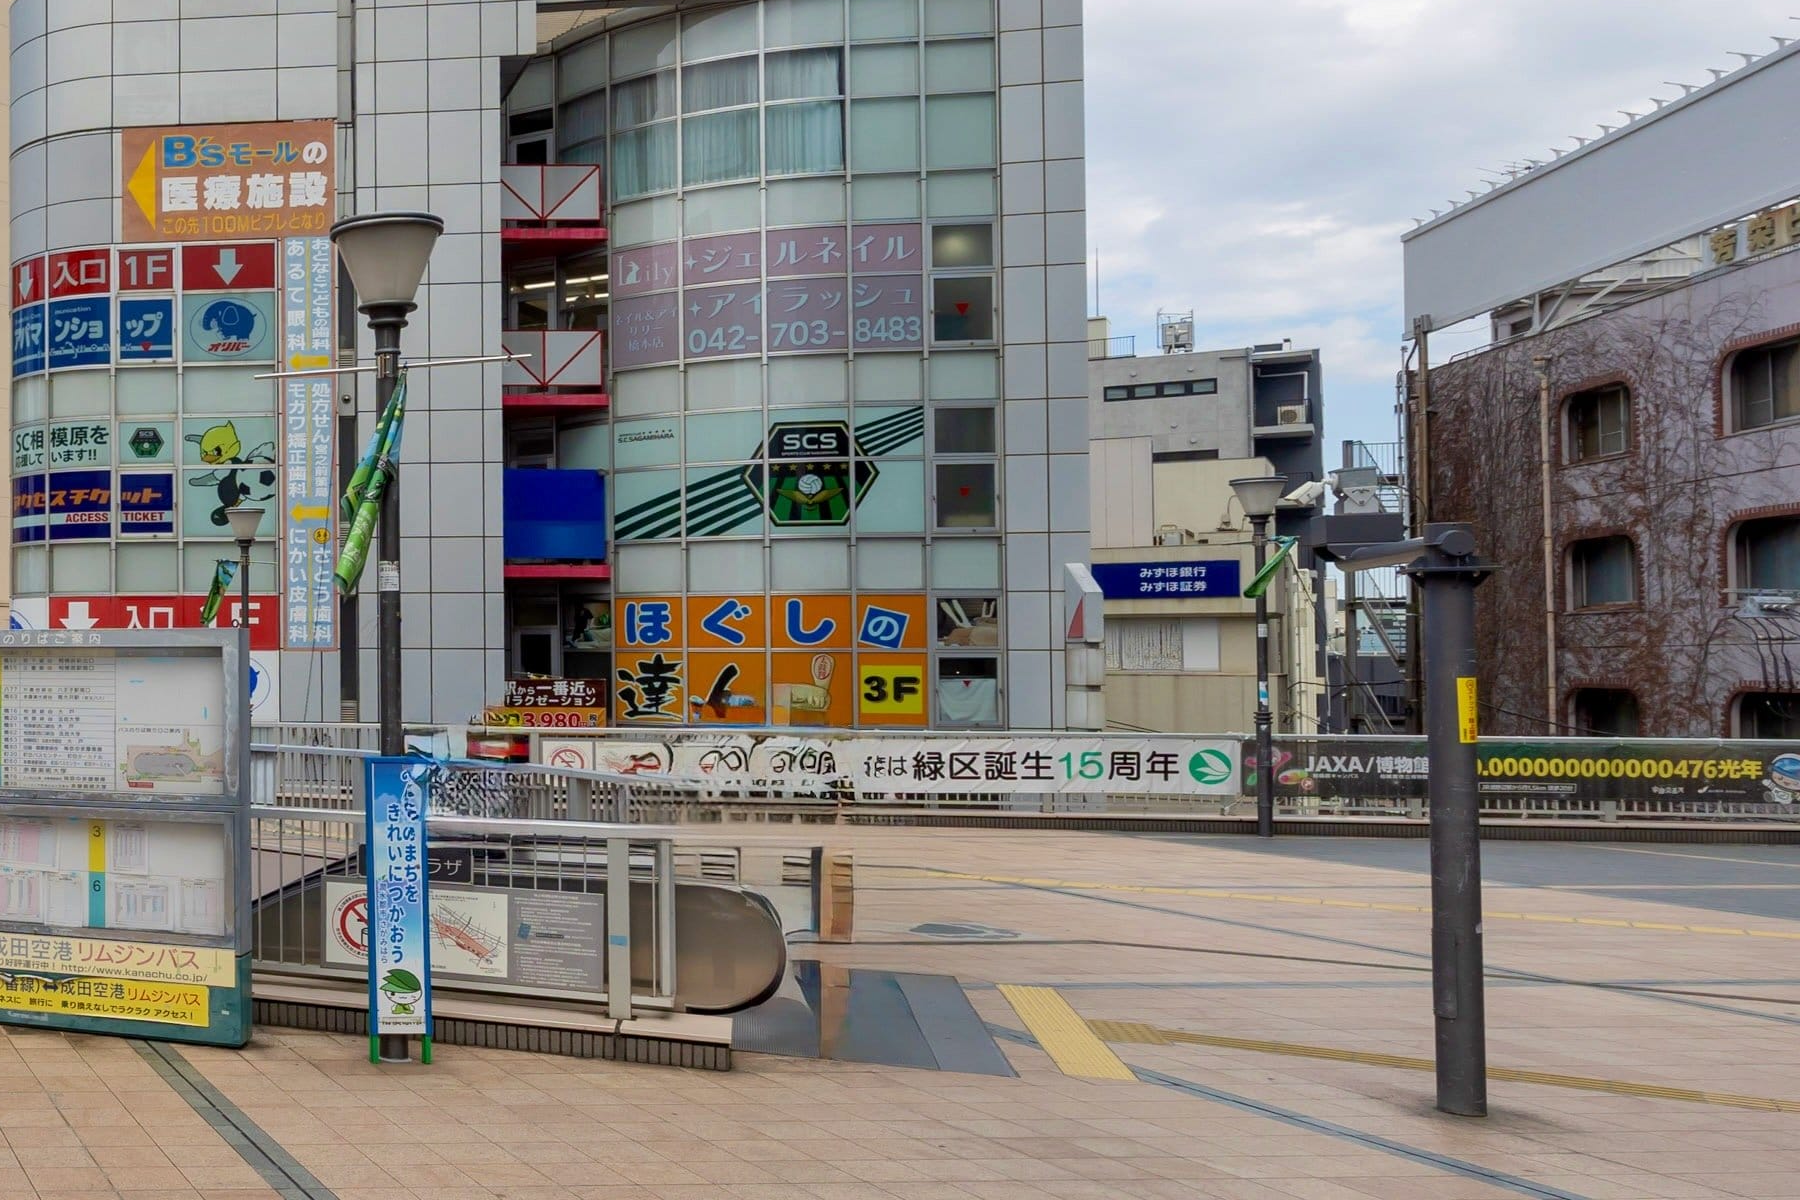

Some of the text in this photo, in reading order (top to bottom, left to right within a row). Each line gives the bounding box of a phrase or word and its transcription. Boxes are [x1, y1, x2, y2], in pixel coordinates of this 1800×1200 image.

[162, 171, 328, 212] 医療施設
[702, 236, 915, 275] ジェルネイル
[53, 255, 168, 289] 入口 1F
[287, 240, 305, 351] あるて眼科
[311, 238, 330, 350] おとなとこどもの歯科
[707, 284, 921, 319] アイラッシュ
[14, 311, 164, 350] アパマンショップ
[689, 316, 921, 354] 042-703-8483
[207, 341, 252, 353] オリバー
[15, 425, 110, 450] SC相模原を
[288, 383, 306, 498] モガワ矯正歯科
[783, 432, 838, 450] SCS
[13, 487, 163, 509] アクセスチケット
[65, 511, 166, 523] ACCESS TICKET
[289, 528, 308, 643] にかい皮膚科
[1139, 566, 1207, 578] みずほ銀行
[1139, 580, 1207, 592] みずほ証券
[313, 547, 332, 643] さとう歯科
[624, 598, 901, 646] ほぐしの
[863, 675, 920, 704] 3F
[1477, 757, 1763, 780] .000000000000476光年
[387, 803, 405, 964] きれいにつかおう
[78, 941, 200, 970] リムジンバス
[61, 963, 208, 983] http://www.kanachu.co.jp/
[28, 997, 54, 1008] 旅行に
[61, 1000, 151, 1017] 乗り換えなしでラクラク
[60, 981, 125, 1000] 成田空港
[127, 987, 201, 1007] リムジンバス
